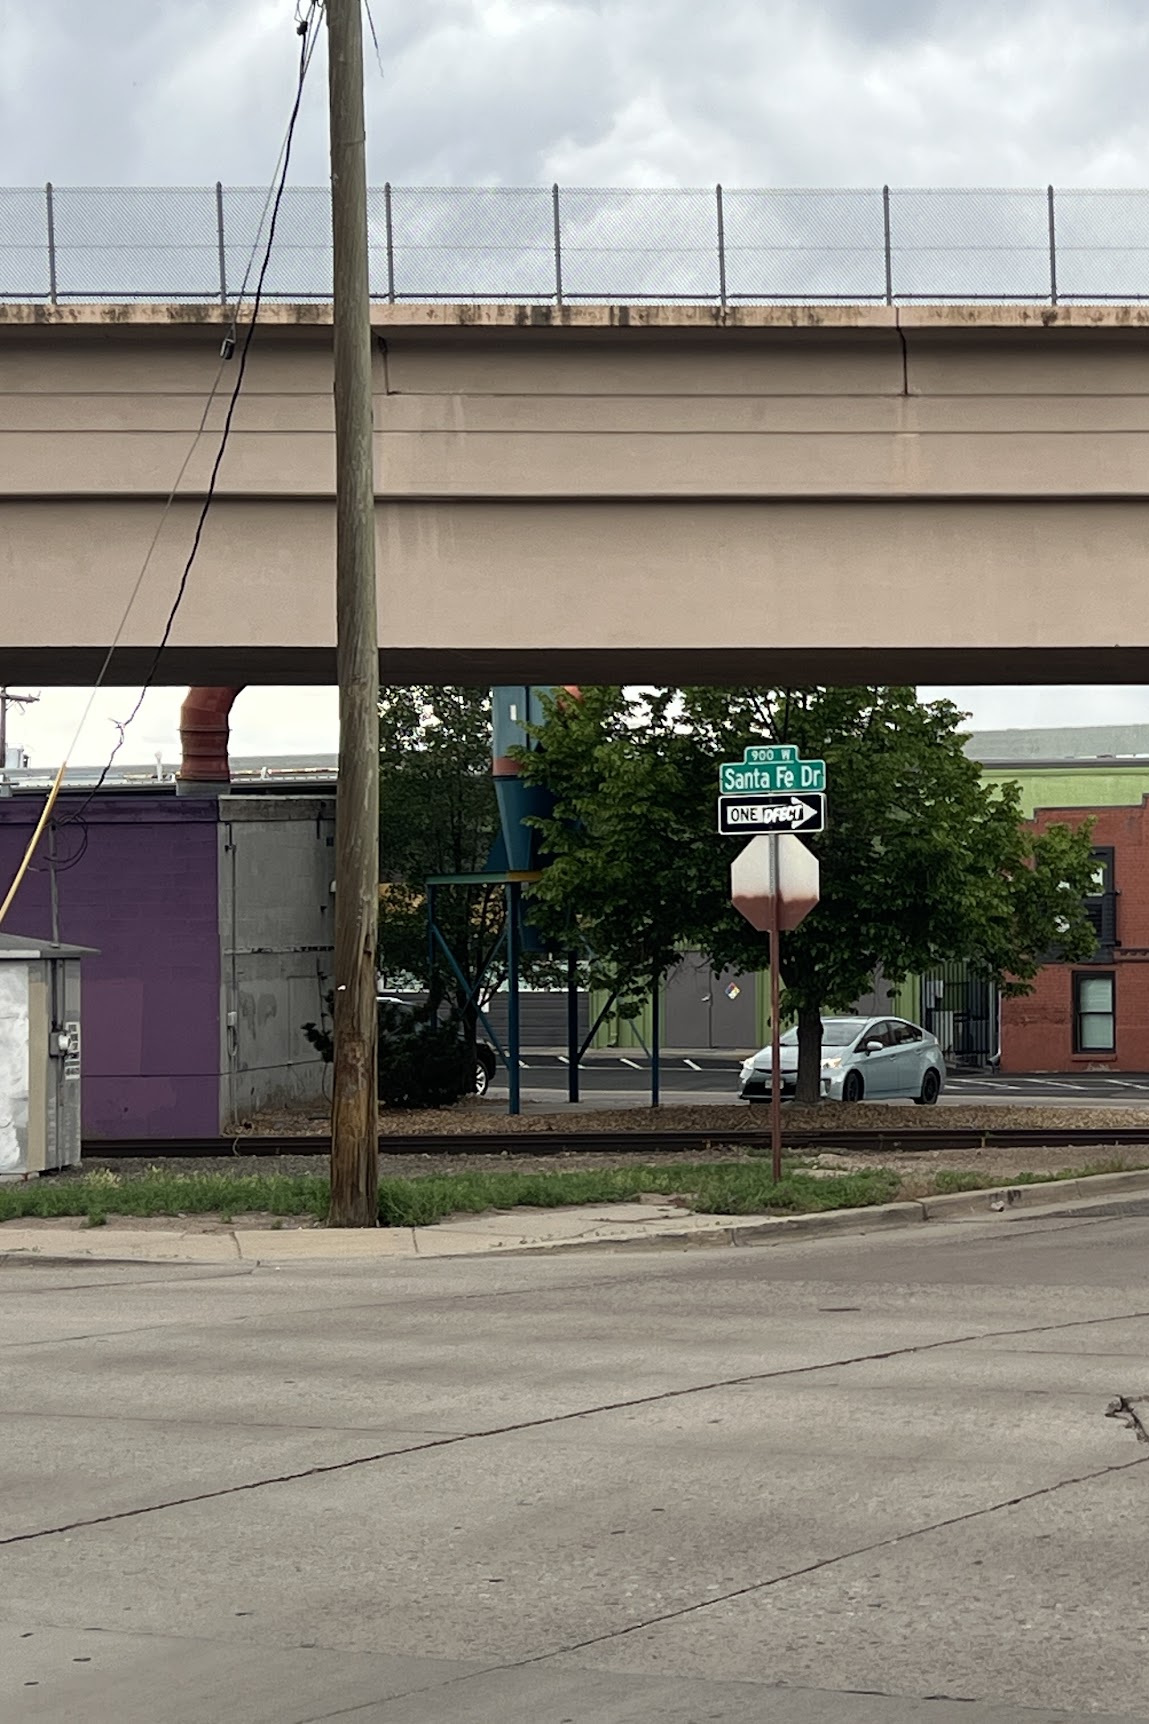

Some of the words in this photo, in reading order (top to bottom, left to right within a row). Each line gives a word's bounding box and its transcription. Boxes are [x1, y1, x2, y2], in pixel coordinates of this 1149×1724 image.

[751, 750, 774, 761] 900
[781, 749, 791, 760] W
[724, 768, 770, 790] Santa
[776, 766, 795, 788] Fe
[801, 765, 821, 787] Dr
[731, 807, 758, 822] ONE
